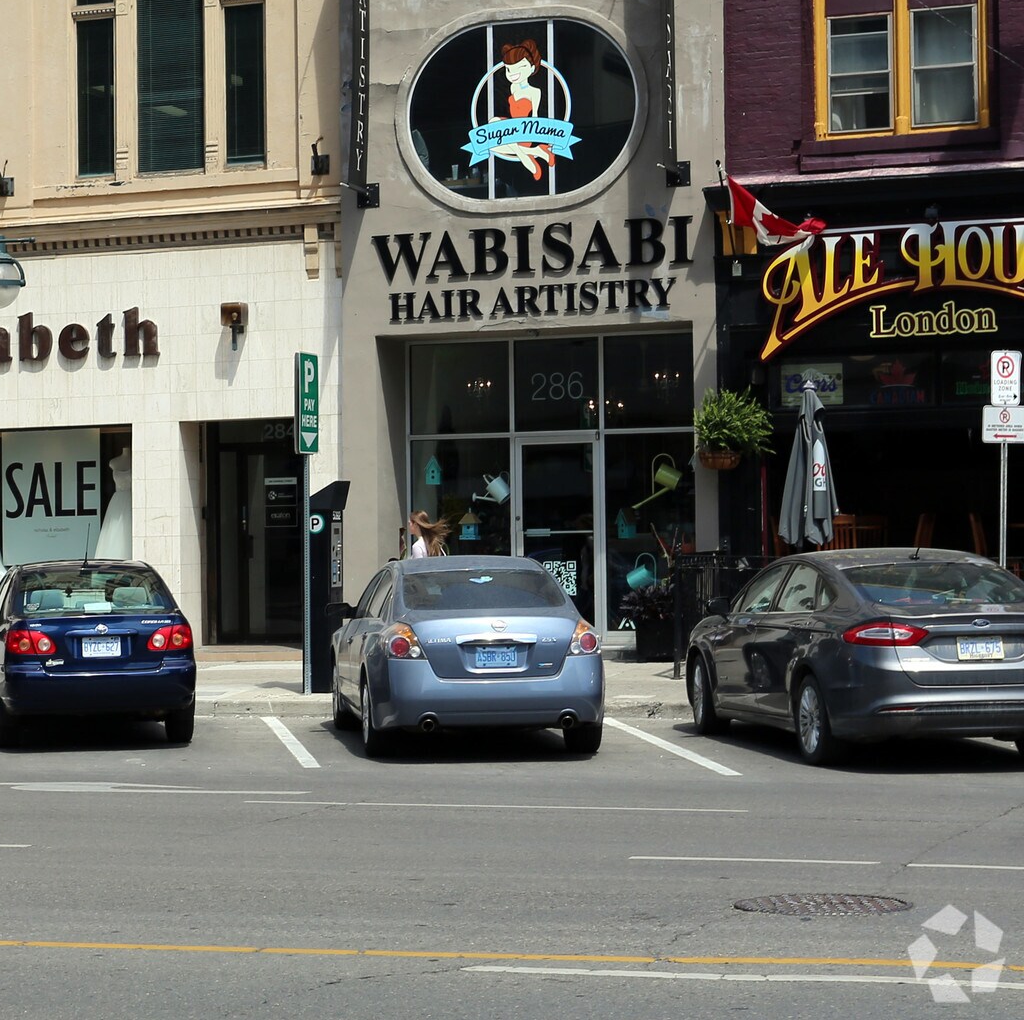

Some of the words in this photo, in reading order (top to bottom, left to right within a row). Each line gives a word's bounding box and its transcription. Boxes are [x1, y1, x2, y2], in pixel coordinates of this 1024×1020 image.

[476, 127, 519, 145] Sugar
[521, 120, 566, 138] Mama
[371, 215, 694, 282] WABISABI
[389, 287, 484, 322] HAIR
[489, 277, 678, 318] ARTISTRY
[760, 230, 879, 361] ALE
[869, 301, 998, 338] London
[531, 371, 585, 401] 286
[301, 414, 318, 428] HERE
[304, 398, 315, 411] PAY
[5, 461, 98, 519] SALE
[311, 517, 320, 530] P
